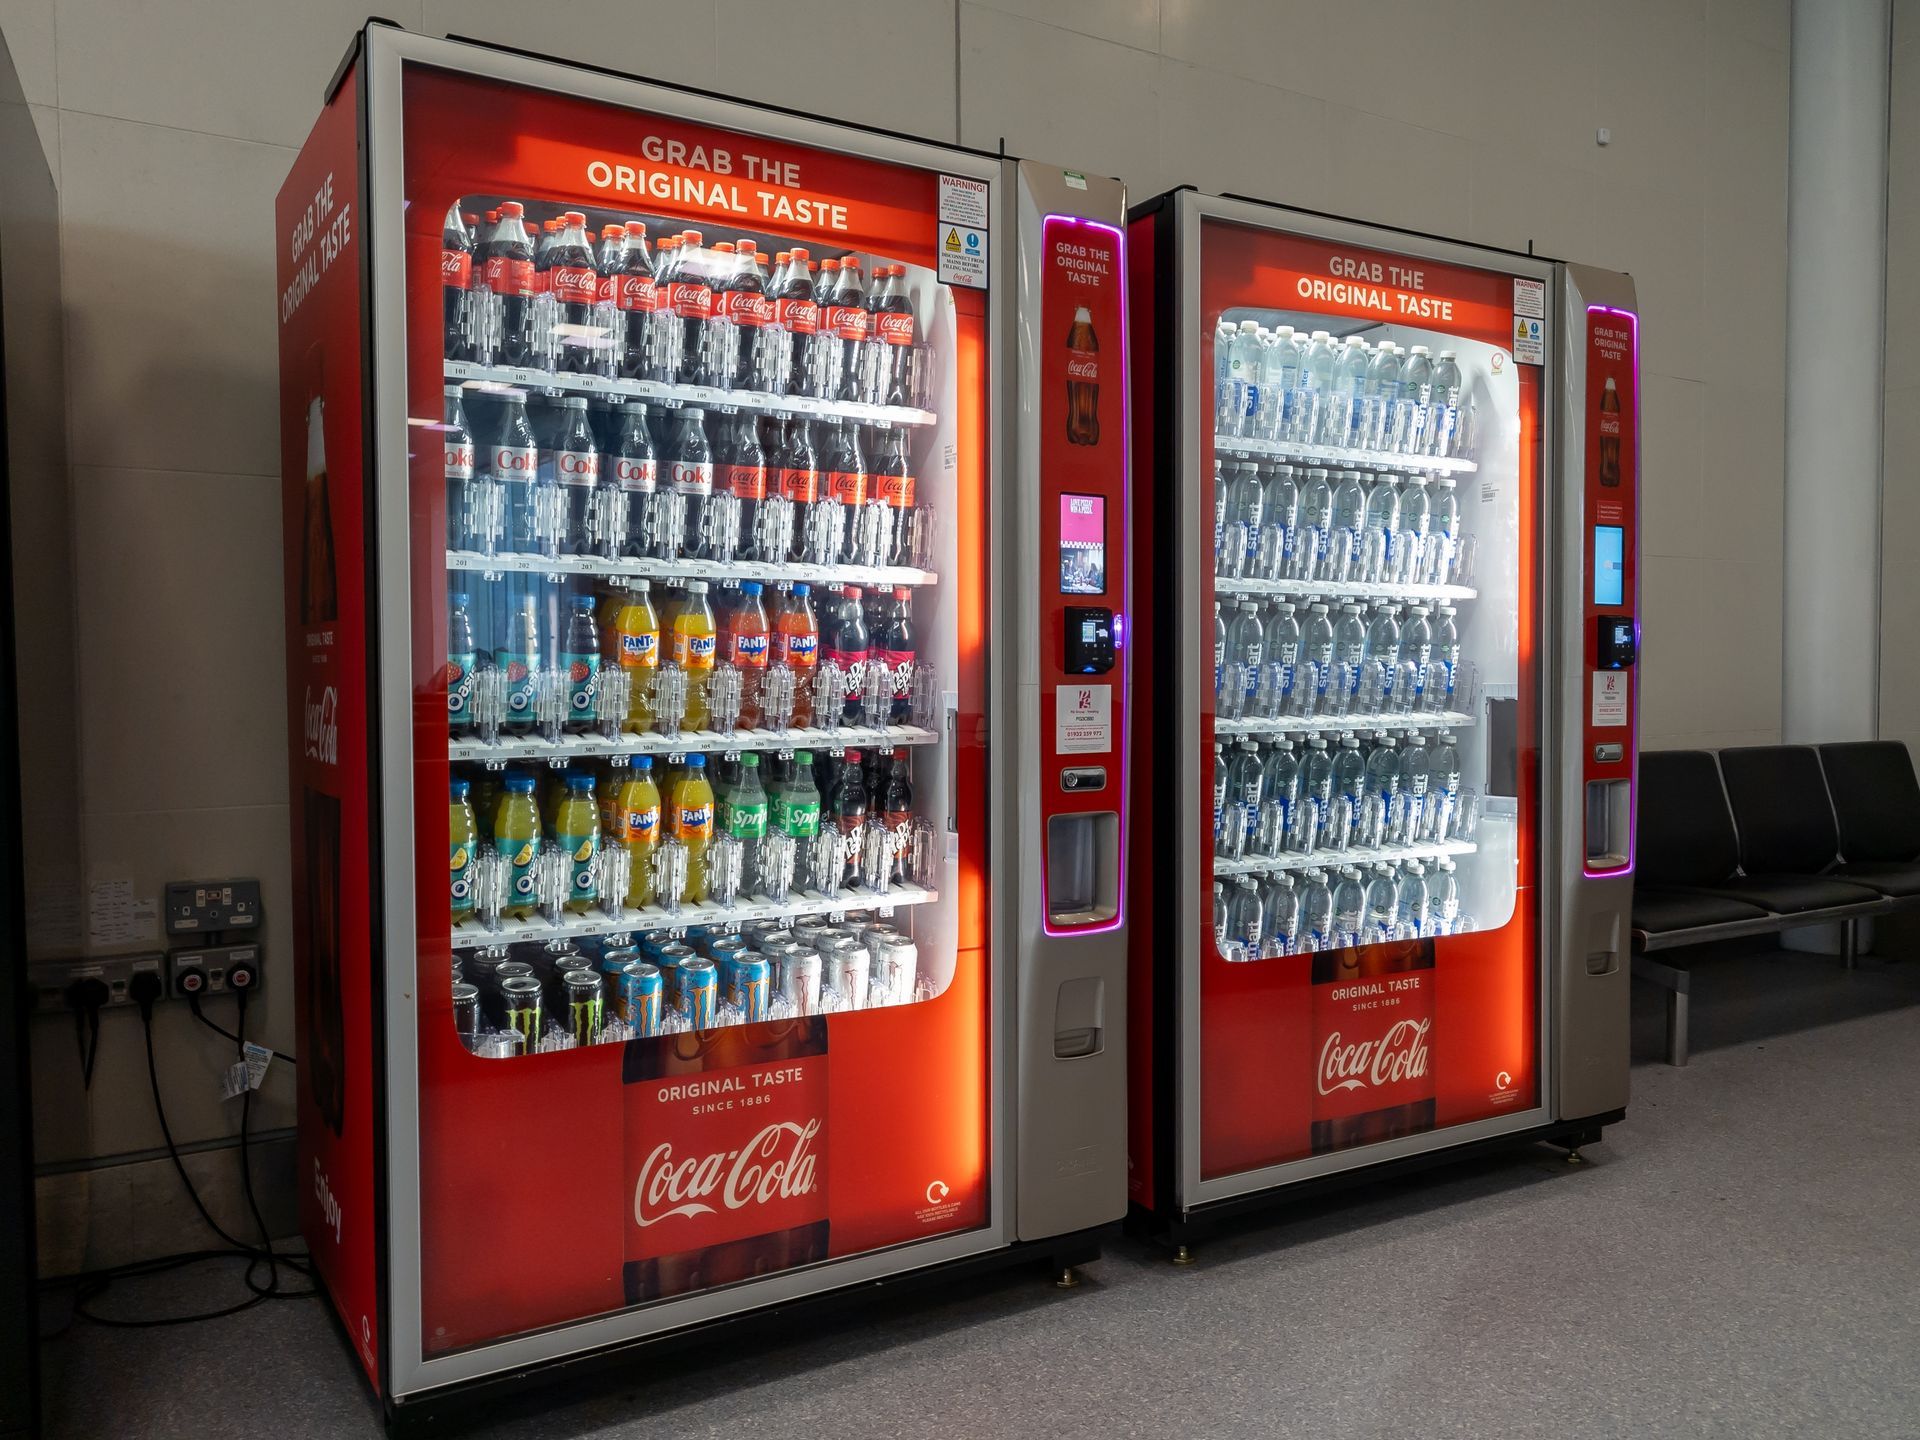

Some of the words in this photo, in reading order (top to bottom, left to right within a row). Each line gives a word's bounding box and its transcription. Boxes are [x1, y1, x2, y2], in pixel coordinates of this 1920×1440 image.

[641, 136, 732, 175] GRAB
[742, 154, 800, 189] THE
[942, 176, 985, 193] WARNING!
[292, 204, 313, 263] GRAB
[315, 172, 333, 228] THE
[587, 161, 748, 213] ORIGINAL
[757, 191, 848, 230] TASTE
[282, 250, 319, 324] ORIGINAL
[320, 203, 350, 273] TASTE
[1056, 242, 1086, 257] GRAB
[1089, 248, 1110, 261] THE
[1057, 256, 1109, 275] ORIGINAL
[1330, 256, 1383, 283] GRAB
[1389, 266, 1424, 290] THE
[1067, 271, 1100, 286] TASTE
[1297, 278, 1392, 311] ORIGINAL
[1397, 294, 1453, 321] TASTE
[1515, 279, 1543, 291] WARNING!
[1594, 327, 1613, 338] GRAB
[1615, 330, 1628, 340] THE
[1594, 338, 1627, 351] ORIGINAL
[1600, 349, 1621, 360] TASTE
[1067, 358, 1098, 378] Coca-Cola
[445, 448, 474, 468] oke
[1248, 502, 1262, 550] smart
[1285, 504, 1298, 552] smart
[1319, 507, 1332, 554] smart
[1352, 509, 1363, 555] smart
[1246, 643, 1261, 689] smart
[1282, 642, 1299, 689] smart
[1319, 642, 1333, 688] smart
[1351, 642, 1364, 689] smart
[1384, 644, 1399, 689] smart
[1416, 644, 1430, 687] smart
[1450, 644, 1461, 688] smart
[305, 685, 338, 765] Coca-Cola
[1247, 782, 1261, 828] smart
[1319, 779, 1331, 823] smart
[1352, 776, 1364, 821] smart
[1388, 775, 1399, 818] smart
[1332, 985, 1384, 1001] ORIGINAL
[1388, 977, 1420, 992] TASTE
[1352, 1001, 1377, 1012] SINCE
[1381, 997, 1400, 1007] 1886
[1317, 1017, 1431, 1096] Coca-Cola
[657, 1077, 746, 1103] ORIGINAL
[751, 1067, 803, 1089] TASTE
[692, 1099, 734, 1116] SINCE
[740, 1094, 772, 1108] 1886
[633, 1118, 823, 1228] Coca-Cola
[314, 1156, 341, 1244] Enjoy
